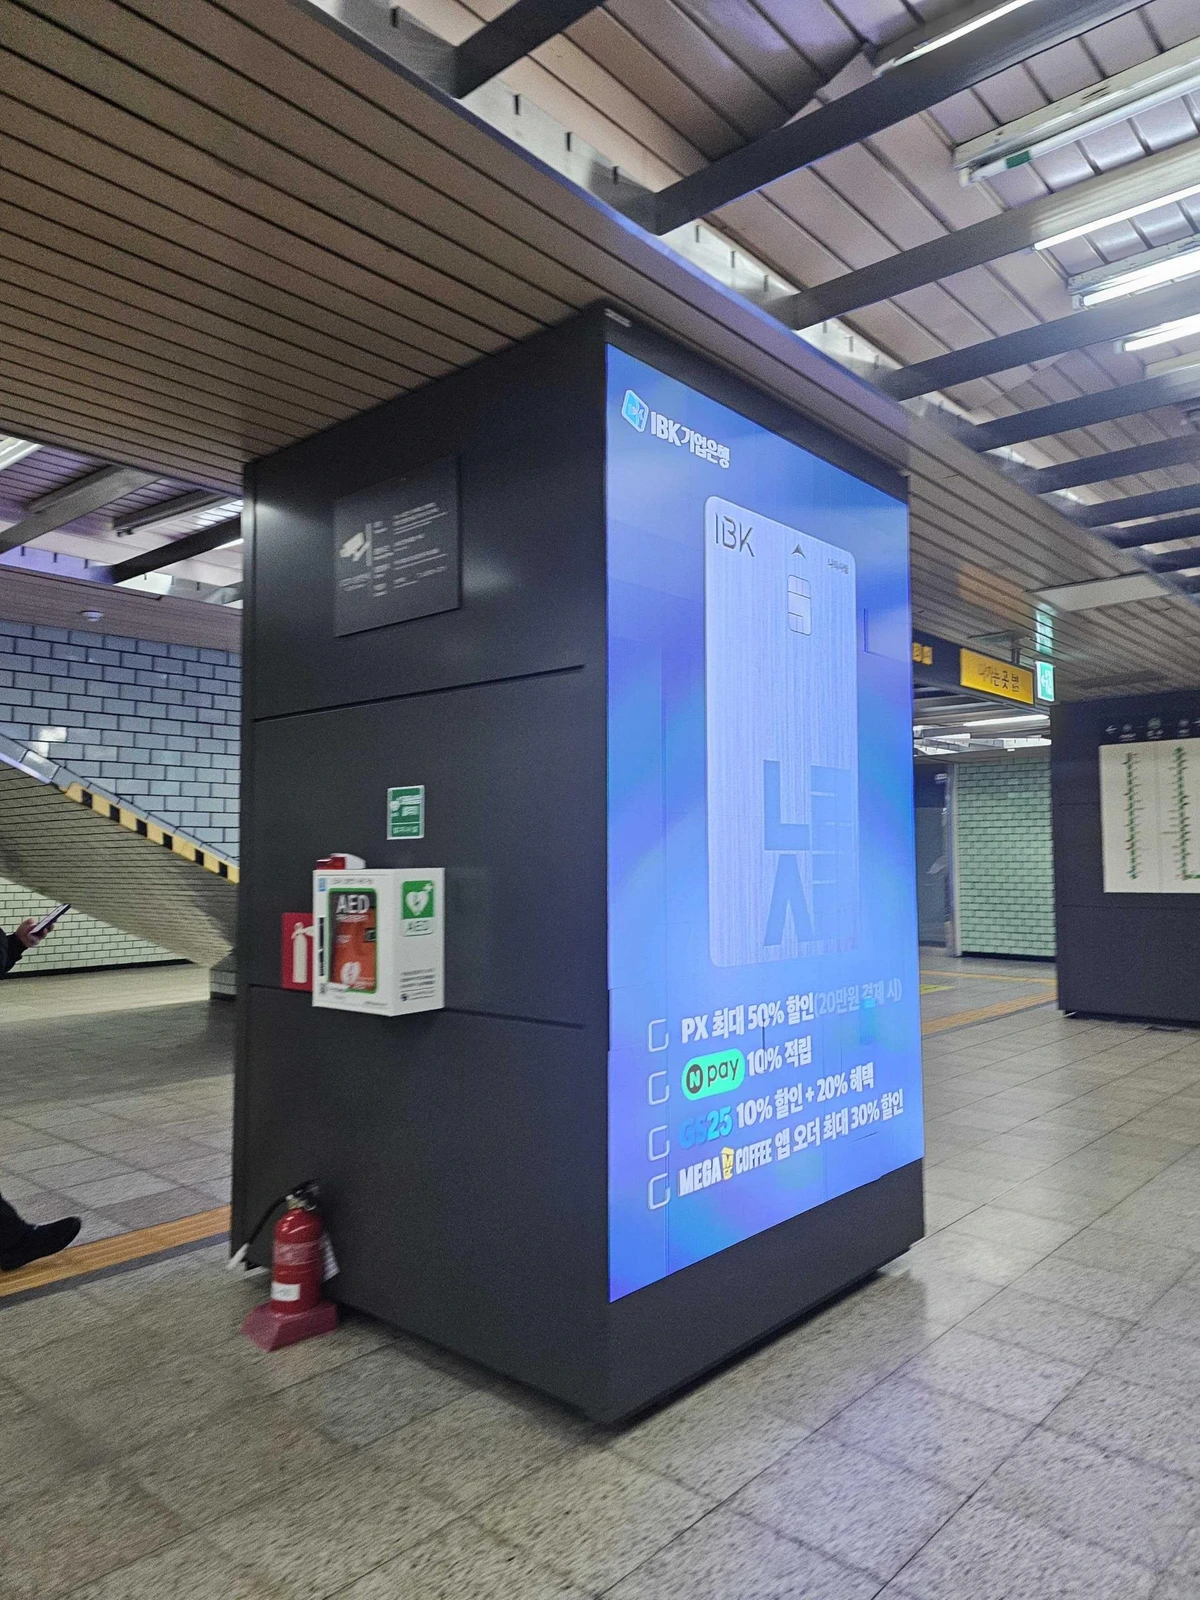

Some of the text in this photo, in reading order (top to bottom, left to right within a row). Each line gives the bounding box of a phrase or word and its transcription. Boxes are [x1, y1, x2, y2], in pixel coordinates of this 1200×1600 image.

[651, 411, 730, 469] IBK기업은행
[715, 513, 755, 558] IBK
[335, 894, 370, 914] AED
[681, 1014, 709, 1044] PX
[712, 1004, 745, 1039] 최대
[747, 1000, 785, 1031] 50%
[862, 979, 885, 1010] 결제
[707, 1058, 739, 1088] pay
[747, 1045, 783, 1077] 10%
[784, 1035, 812, 1068] 적립
[679, 1062, 874, 1149] GS25 10% 할인 + 20% 혜택
[678, 1156, 721, 1197] MEGA
[735, 1138, 773, 1175] COFFEE
[775, 1127, 791, 1161] 앱
[792, 1116, 821, 1153] 오더
[823, 1107, 849, 1140] 최대
[850, 1099, 882, 1130] 30%
[880, 1088, 904, 1121] 할인
